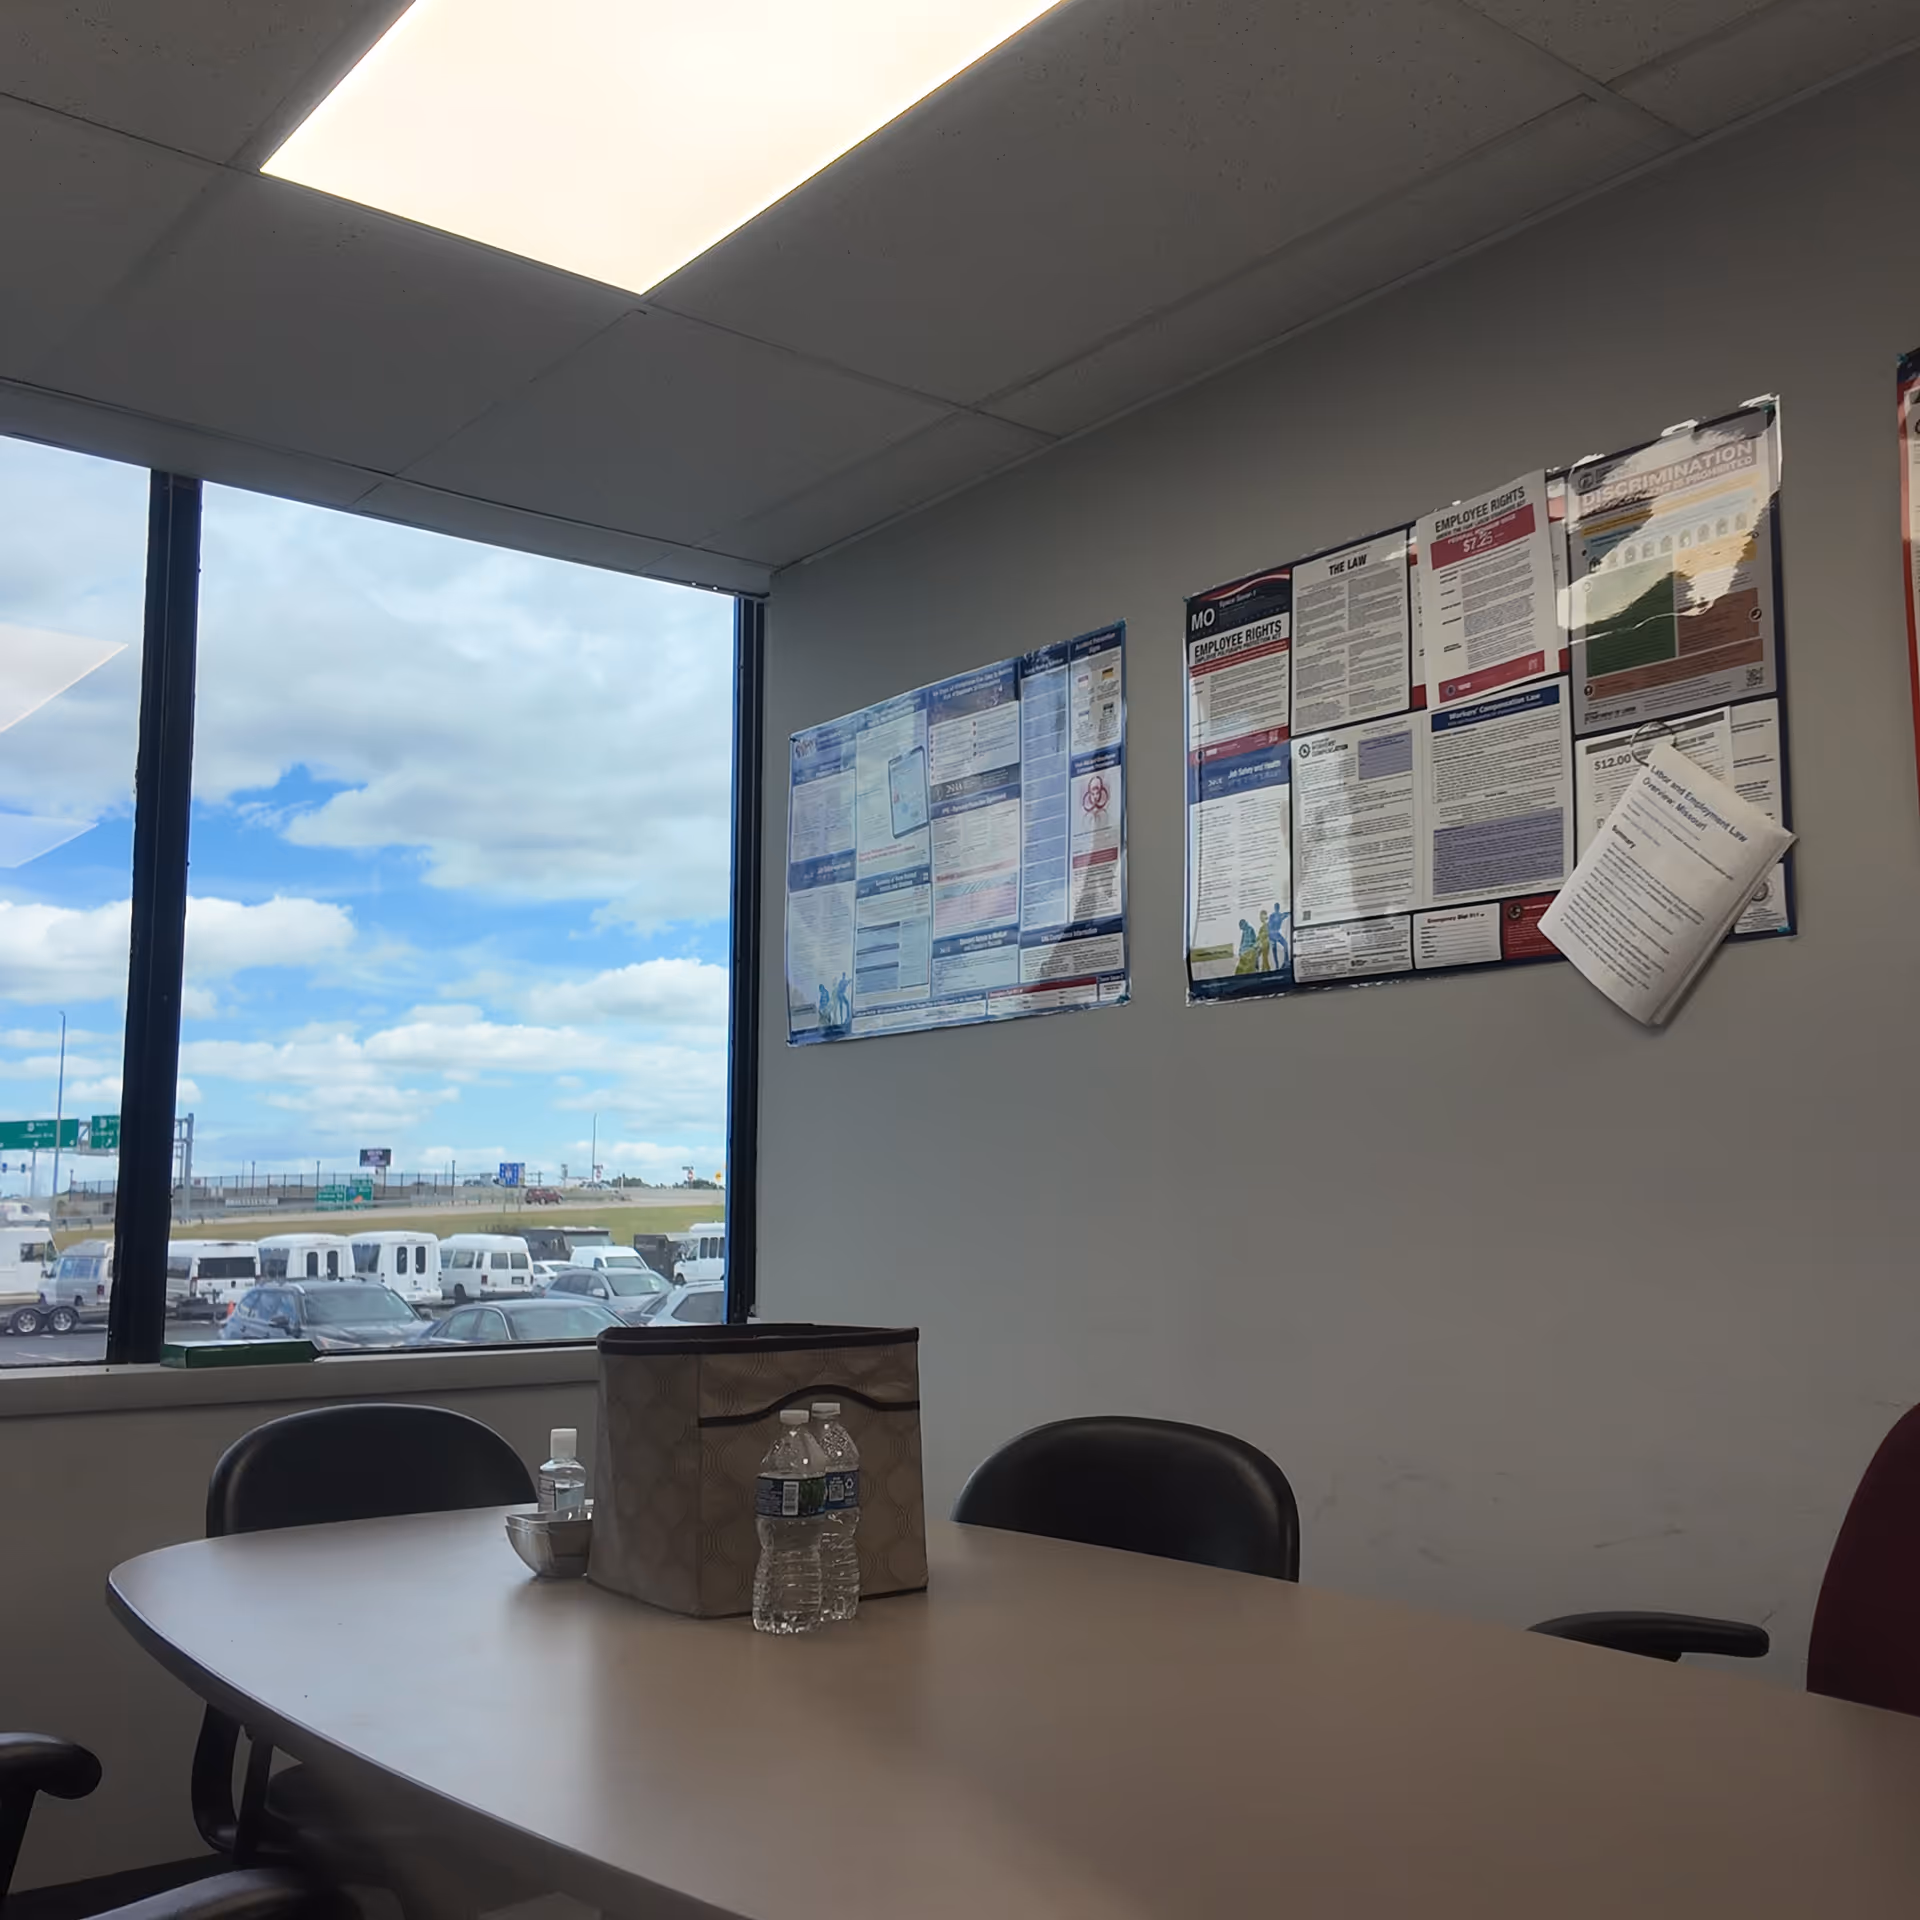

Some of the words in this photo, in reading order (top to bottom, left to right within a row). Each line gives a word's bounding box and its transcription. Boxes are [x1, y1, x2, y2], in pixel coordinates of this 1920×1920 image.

[1582, 441, 1752, 506] DISCRIMINATION
[1435, 502, 1488, 533] EMPLOYEE
[1490, 486, 1525, 512] RIGHTS
[1463, 532, 1492, 553] $7.25
[1329, 561, 1345, 576] THE
[1347, 554, 1367, 570] LAW
[1191, 608, 1215, 632] MO
[1195, 631, 1243, 657] EMPLOYEE
[1246, 620, 1281, 641] RIGHTS
[1479, 697, 1525, 713] Compensation
[1526, 694, 1541, 702] Law
[1594, 753, 1632, 771] $12.00
[1650, 765, 1672, 784] Labor
[1670, 782, 1687, 796] and
[1684, 791, 1730, 830] Employment
[1729, 826, 1748, 842] Law
[1675, 803, 1708, 831] Missouri
